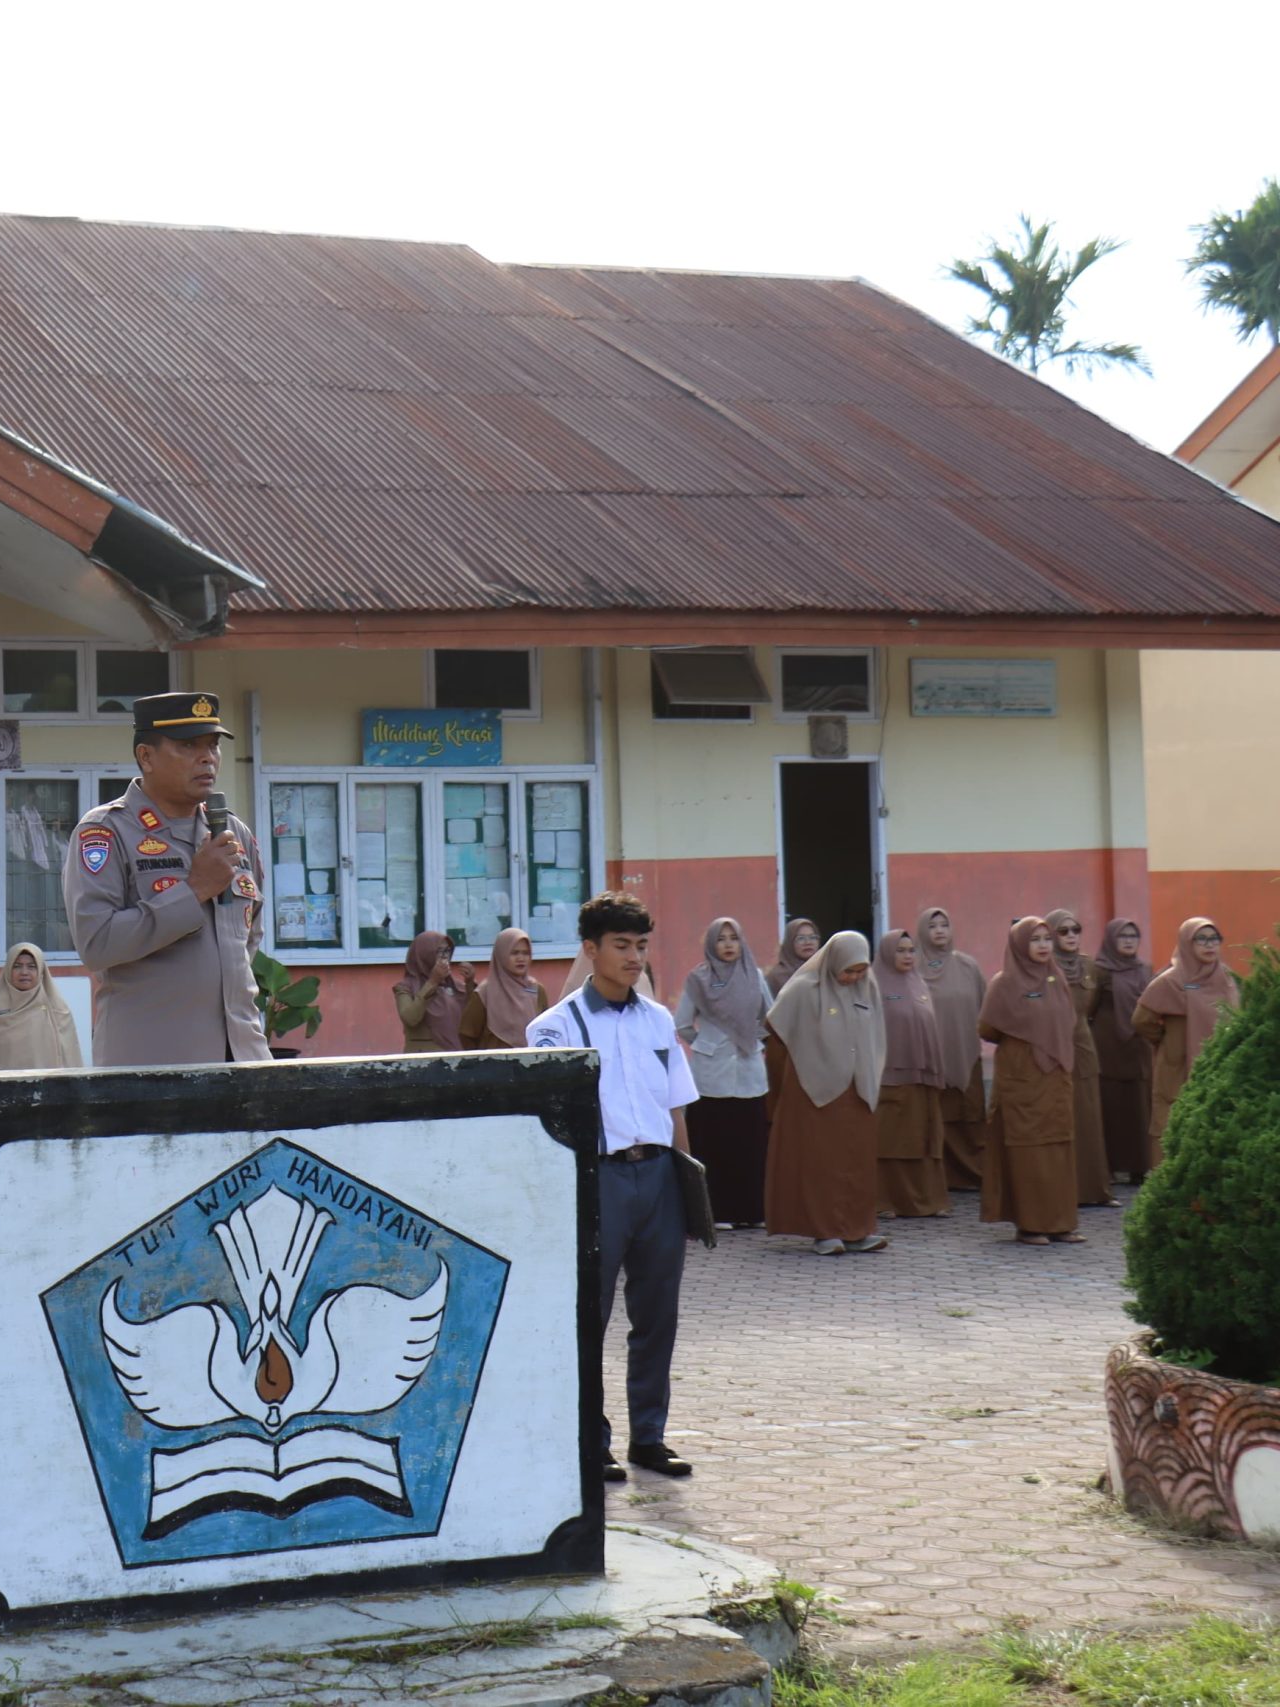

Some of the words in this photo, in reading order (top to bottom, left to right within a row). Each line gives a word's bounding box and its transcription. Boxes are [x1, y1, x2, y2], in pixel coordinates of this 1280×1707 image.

[373, 719, 444, 755] Madding
[445, 720, 492, 746] Kreasi
[114, 1215, 175, 1267] TUT
[193, 1159, 261, 1216] WURI
[287, 1156, 432, 1250] HANDAYANI
